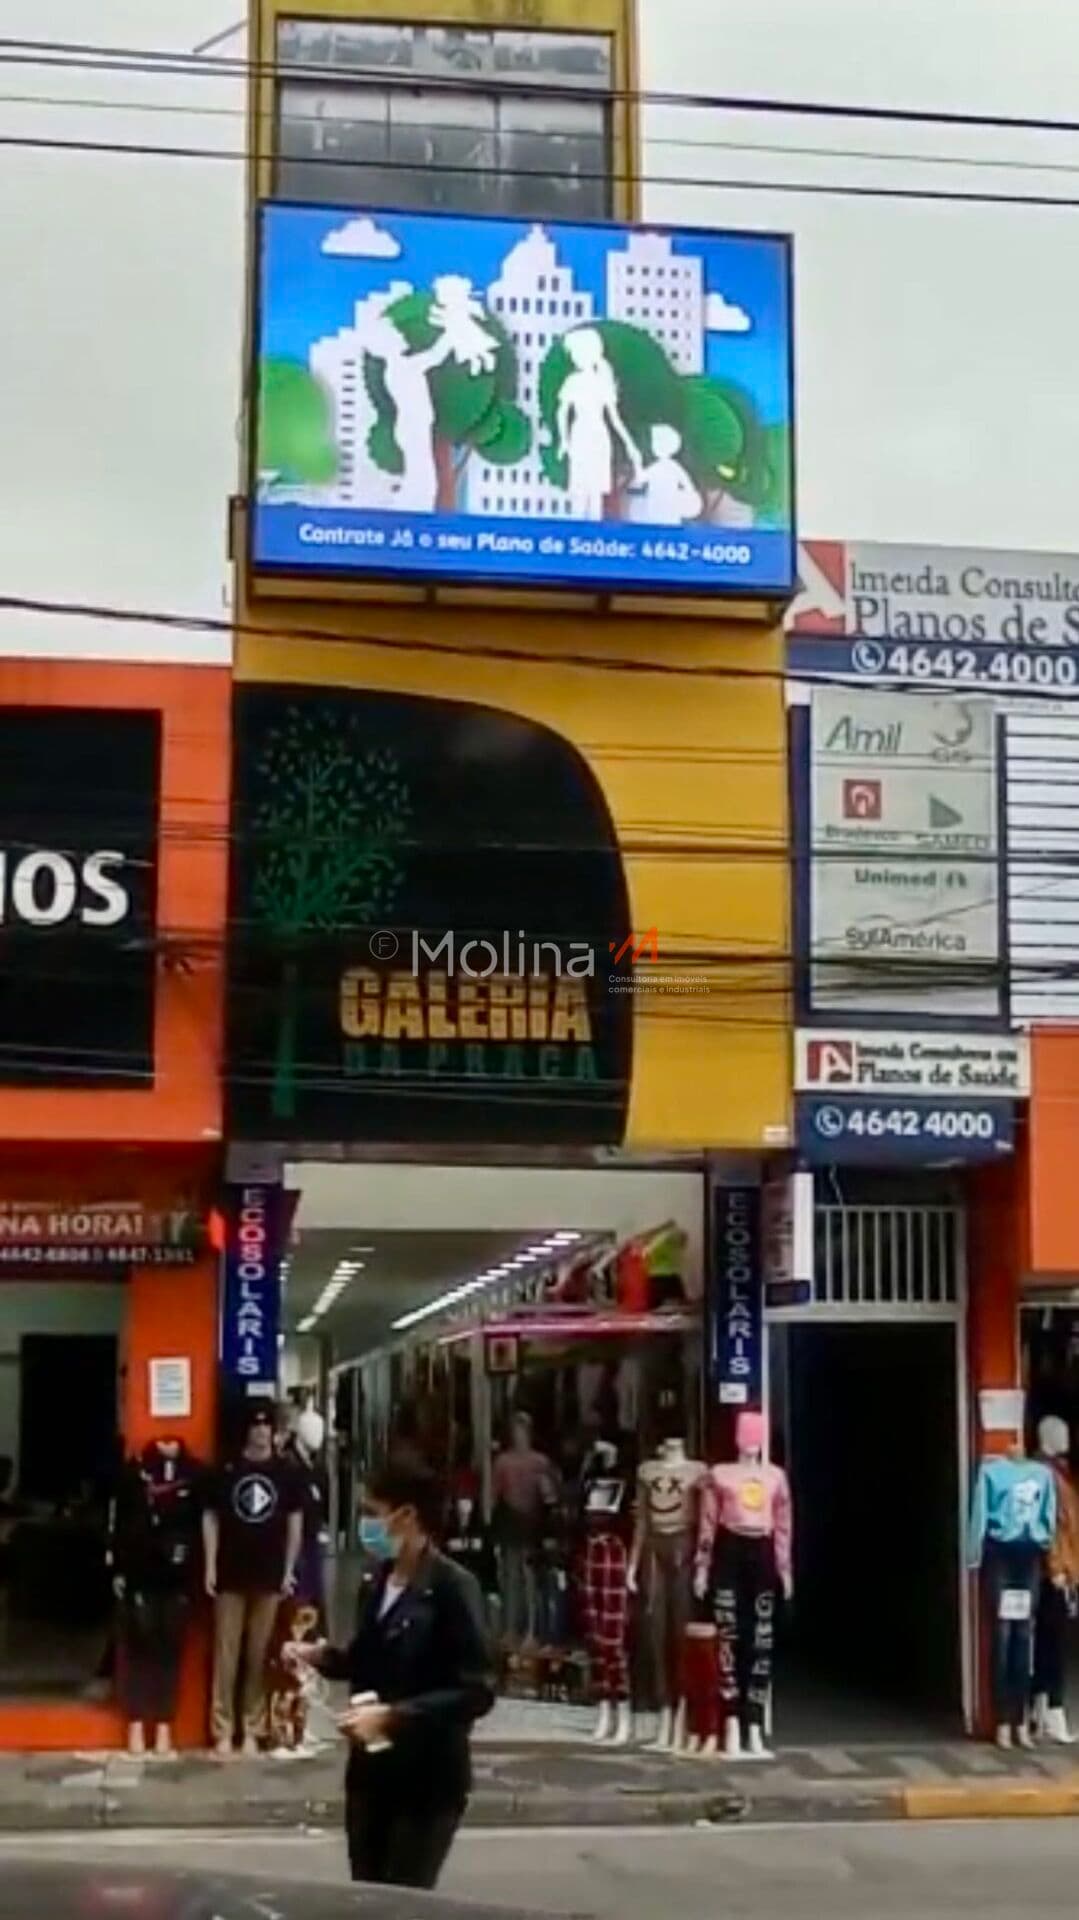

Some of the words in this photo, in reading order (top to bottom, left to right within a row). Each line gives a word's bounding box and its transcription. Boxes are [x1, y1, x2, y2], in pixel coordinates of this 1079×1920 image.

[299, 522, 385, 546] Contrate
[438, 532, 472, 550] seu
[477, 532, 534, 554] Plano
[538, 536, 564, 555] de
[641, 538, 751, 564] 4642-4000
[852, 597, 986, 643] Planos
[1001, 603, 1048, 646] de
[886, 646, 1077, 685] 4642.4000
[825, 715, 902, 753] Amil
[0, 850, 129, 926] OS
[854, 867, 937, 887] Unimed
[340, 967, 593, 1042] GALERIA
[857, 1061, 922, 1084] Planos
[929, 1063, 952, 1085] de
[847, 1109, 922, 1137] 4642
[924, 1111, 994, 1139] 4000
[49, 1213, 145, 1237] HORA!
[236, 1187, 267, 1376] ECOSOLARIS
[724, 1192, 752, 1376] ECOSOLARIS
